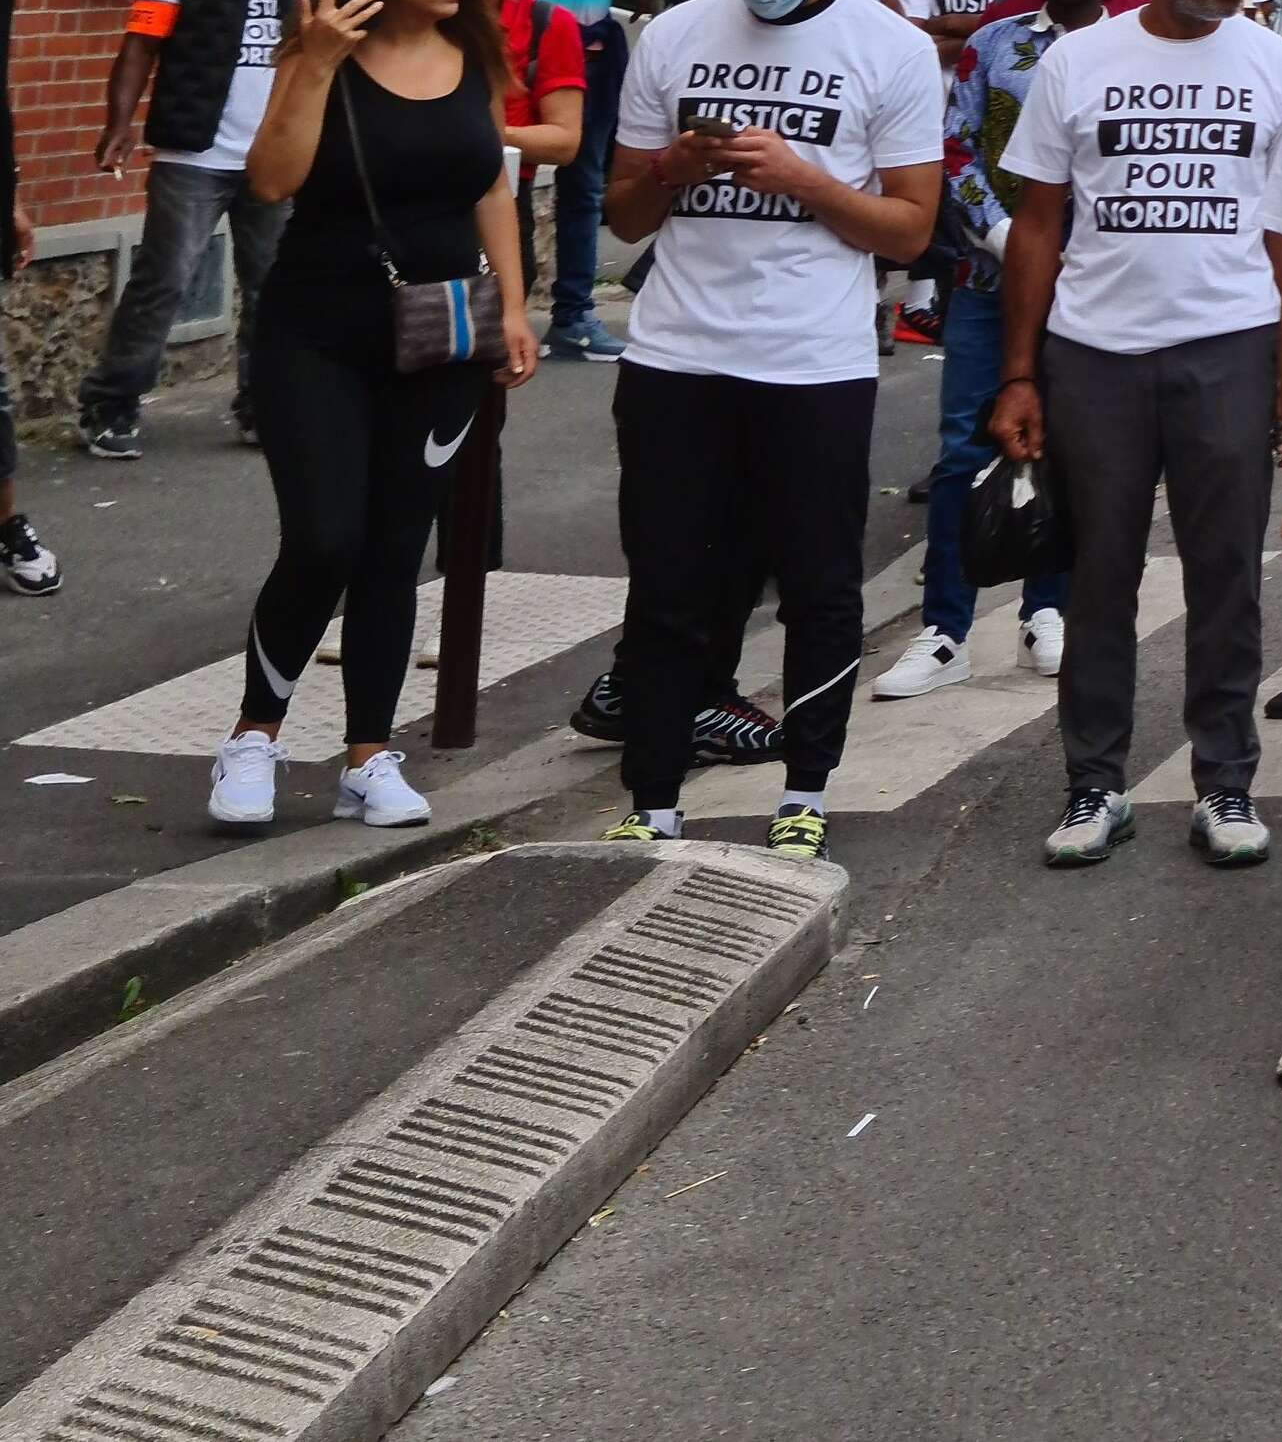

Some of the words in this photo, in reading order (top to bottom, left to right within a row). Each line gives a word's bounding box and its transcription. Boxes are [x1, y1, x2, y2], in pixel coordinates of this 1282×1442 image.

[687, 62, 792, 92] DROIT
[799, 69, 845, 100] DE
[1104, 83, 1203, 111] DROIT
[1215, 85, 1253, 113] DE
[1114, 123, 1242, 151] JUSTICE
[1125, 162, 1216, 189] POUR
[1096, 200, 1238, 230] NORDINE
